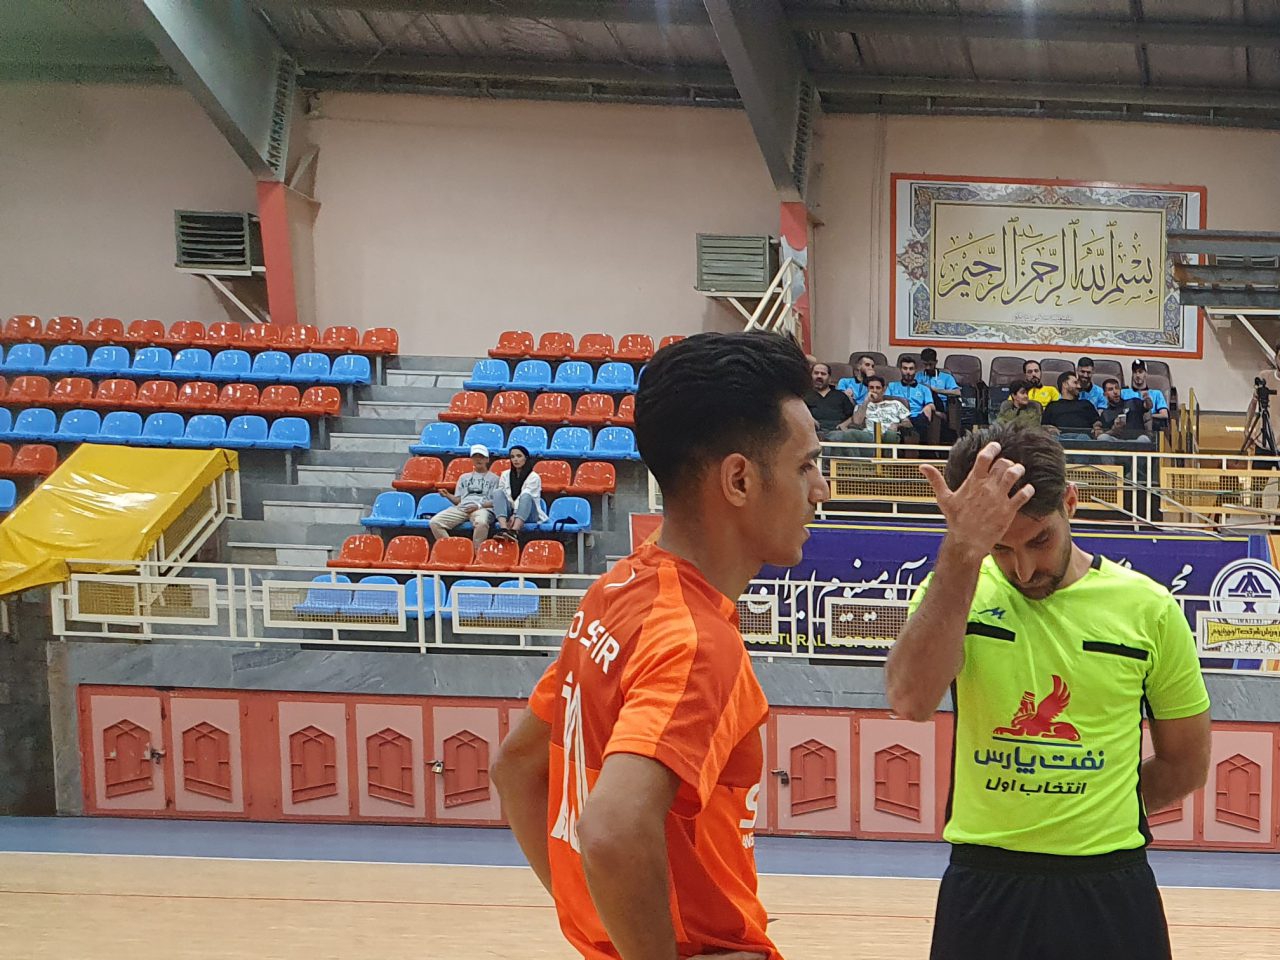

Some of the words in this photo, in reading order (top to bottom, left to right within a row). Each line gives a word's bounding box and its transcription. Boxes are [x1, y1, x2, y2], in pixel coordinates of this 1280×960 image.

[973, 745, 1038, 774] پارس
[1039, 749, 1105, 771] نفت
[985, 776, 1016, 792] اول
[1018, 781, 1087, 796] انتخاب
